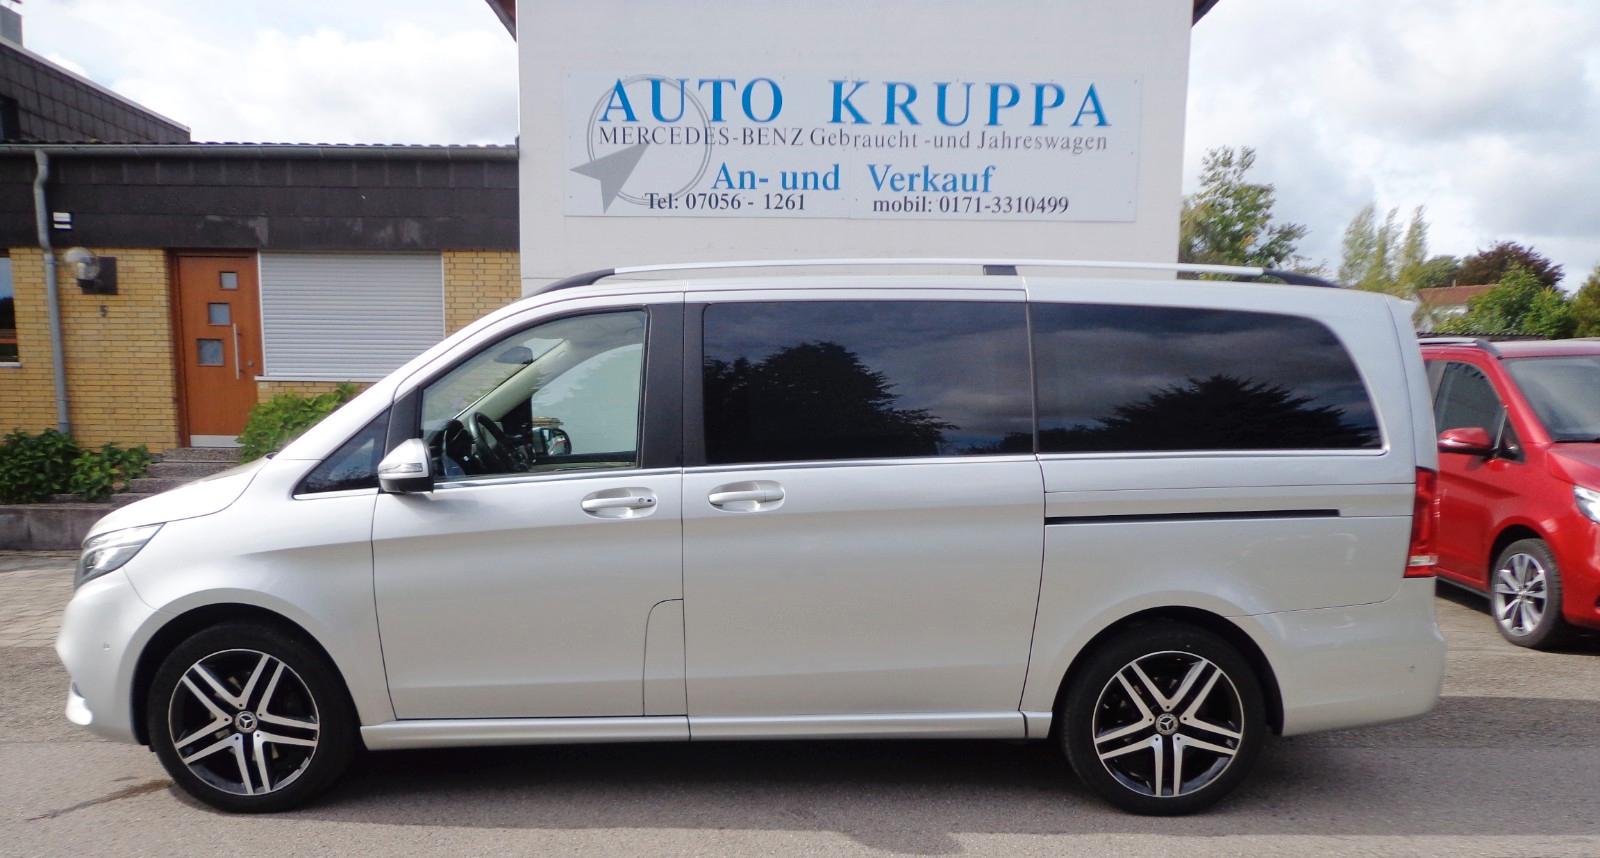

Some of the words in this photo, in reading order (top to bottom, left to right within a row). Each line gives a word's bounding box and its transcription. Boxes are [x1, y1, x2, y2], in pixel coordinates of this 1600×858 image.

[598, 77, 783, 123] AUTO
[827, 79, 1112, 127] KRUPPA
[598, 126, 804, 146] MERCEDES-BENZ
[810, 128, 918, 149] Gebraucht
[977, 131, 1107, 154] Jahreswagen
[711, 161, 769, 190] An-
[780, 163, 841, 191] und
[867, 164, 997, 193] Verkauf
[644, 193, 679, 210] Tel:
[685, 193, 742, 210] 07056
[764, 193, 805, 210] 1261
[873, 196, 932, 213] mobil:
[939, 197, 1069, 214] 0171-3310499
